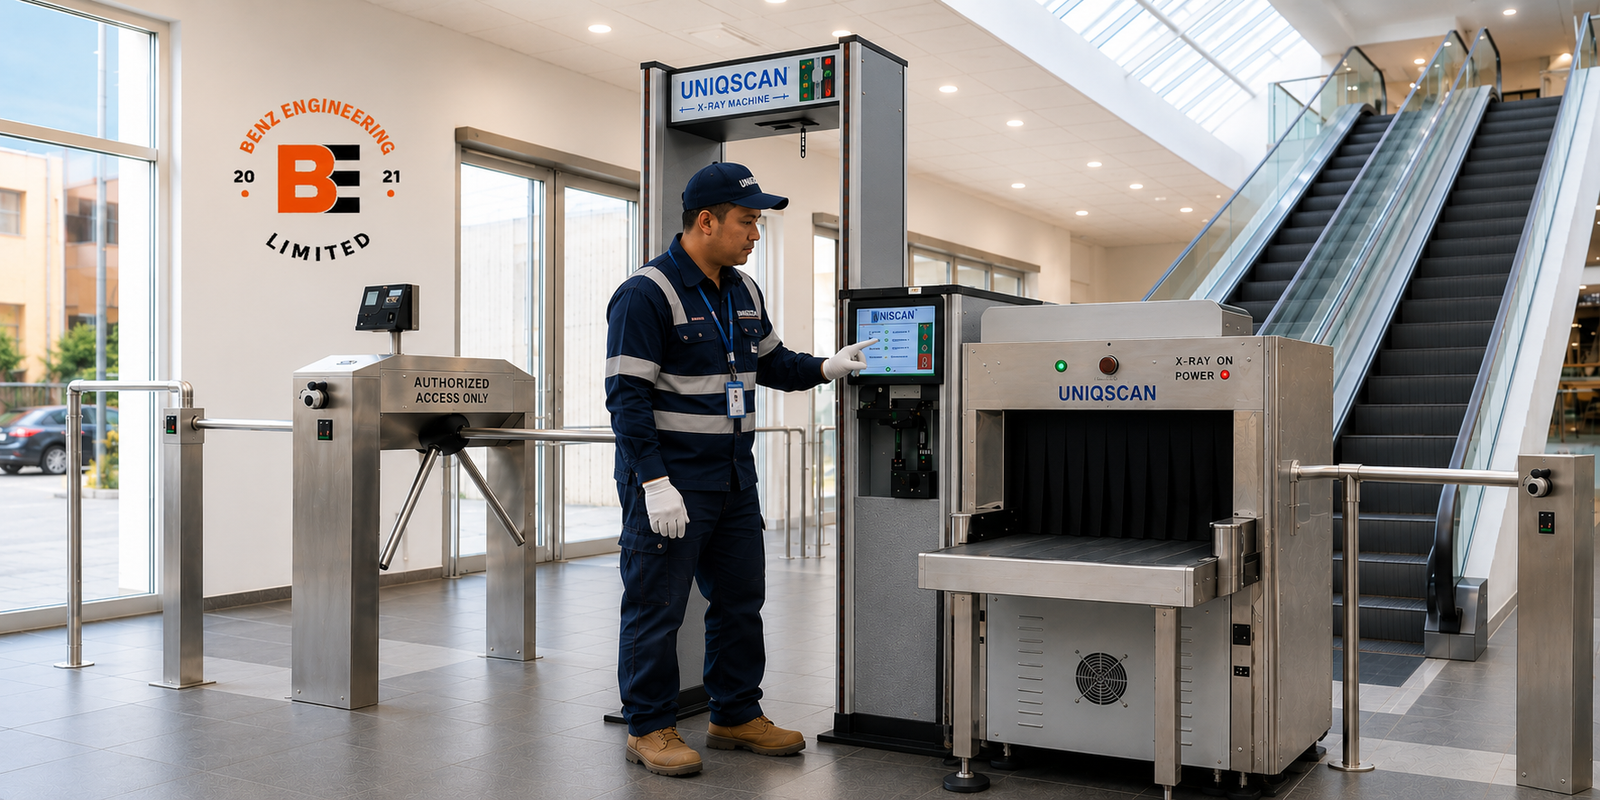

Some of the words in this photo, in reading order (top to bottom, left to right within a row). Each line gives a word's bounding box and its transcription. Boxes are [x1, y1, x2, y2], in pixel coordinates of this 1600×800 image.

[681, 66, 788, 100] UNIQSCAN
[697, 100, 726, 112] X-RAY
[728, 95, 770, 108] MACHINE
[239, 110, 281, 154] BENZ
[280, 98, 395, 156] ENGINEERING
[233, 170, 255, 183] 20
[277, 144, 360, 213] BE
[382, 170, 401, 183] 21
[265, 232, 370, 261] LIMITED
[1175, 356, 1211, 366] X-RAY
[1216, 356, 1233, 365] ON
[414, 377, 490, 389] AUTHORIZED
[1175, 371, 1214, 380] POWER
[415, 392, 460, 404] ACCESS
[463, 392, 489, 404] ONLY
[1058, 385, 1156, 402] UNIQSCAN
